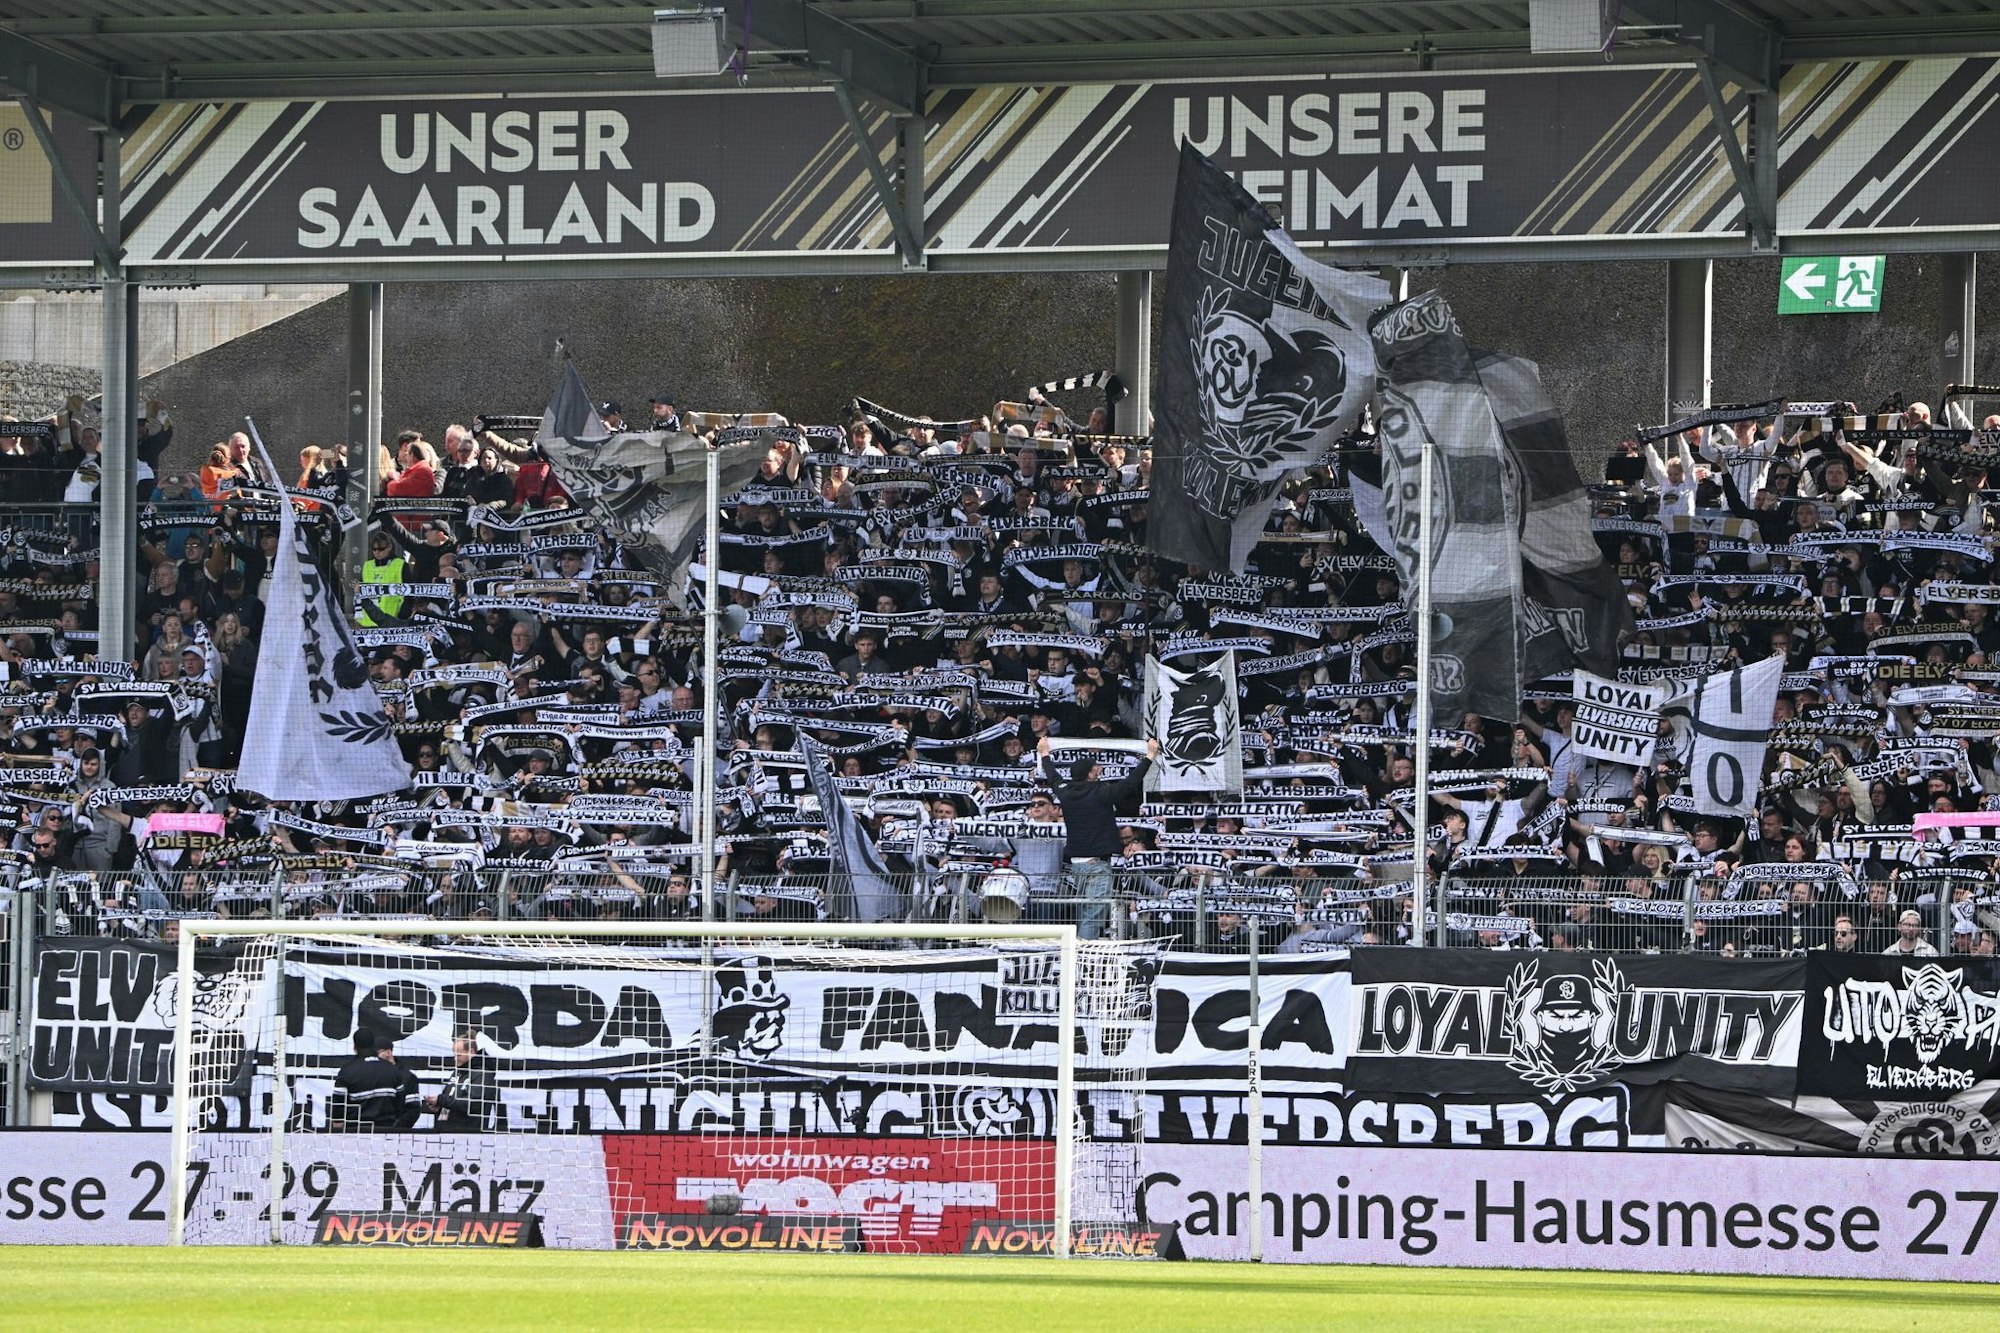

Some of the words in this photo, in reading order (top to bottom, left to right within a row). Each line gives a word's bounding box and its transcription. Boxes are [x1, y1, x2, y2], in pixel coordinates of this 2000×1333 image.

[1173, 89, 1487, 158] UNSERE
[380, 109, 633, 175] UNSER
[1222, 162, 1485, 230] EIMAT
[297, 181, 717, 249] SAARLAND
[542, 507, 584, 523] SAARLAND
[1864, 502, 1936, 512] ELVERSBERG
[140, 519, 154, 529] SV
[155, 515, 218, 526] ELVERSBERG
[1062, 590, 1143, 601] SAARLAND
[1186, 585, 1263, 601] ELVERSBERG
[1759, 609, 1775, 617] DEM
[1895, 623, 1973, 634] ELVERSBERG
[1879, 666, 1910, 679] DIE
[1914, 666, 1947, 678] ELV
[81, 683, 97, 694] SV
[100, 682, 171, 692] ELVERSBERG
[1315, 680, 1407, 698] ELVERSBERG
[21, 714, 116, 728] ELVERSBERG
[1576, 704, 1660, 733] ELVERSBERG
[1574, 726, 1650, 757] UNITY
[438, 772, 463, 784] BLOCK
[464, 772, 470, 784] C
[598, 767, 614, 775] AUS
[616, 767, 635, 775] DEM
[636, 767, 679, 778] SAARLAND
[89, 793, 106, 807] SV
[109, 785, 194, 801] ELVERSBERG
[355, 800, 417, 814] ELVERSBERG
[1144, 805, 1204, 817] JUGEND
[1217, 804, 1300, 816] KOLLEKTIV
[956, 823, 1014, 838] JUGEND
[1843, 824, 1858, 834] SV
[155, 837, 187, 847] DIE
[1900, 870, 1912, 880] SV
[1915, 869, 1987, 880] ELVERSBERG
[37, 950, 158, 1022] ELV
[820, 978, 1335, 1056] FANICA
[1357, 983, 1516, 1058] LOYAL
[1611, 990, 1804, 1064] UNITY
[1866, 1063, 1976, 1090] ELVERSBERG
[733, 1149, 930, 1176] wohnwagen
[0, 1177, 106, 1221] sse
[629, 1221, 848, 1250] NOVOLINE
